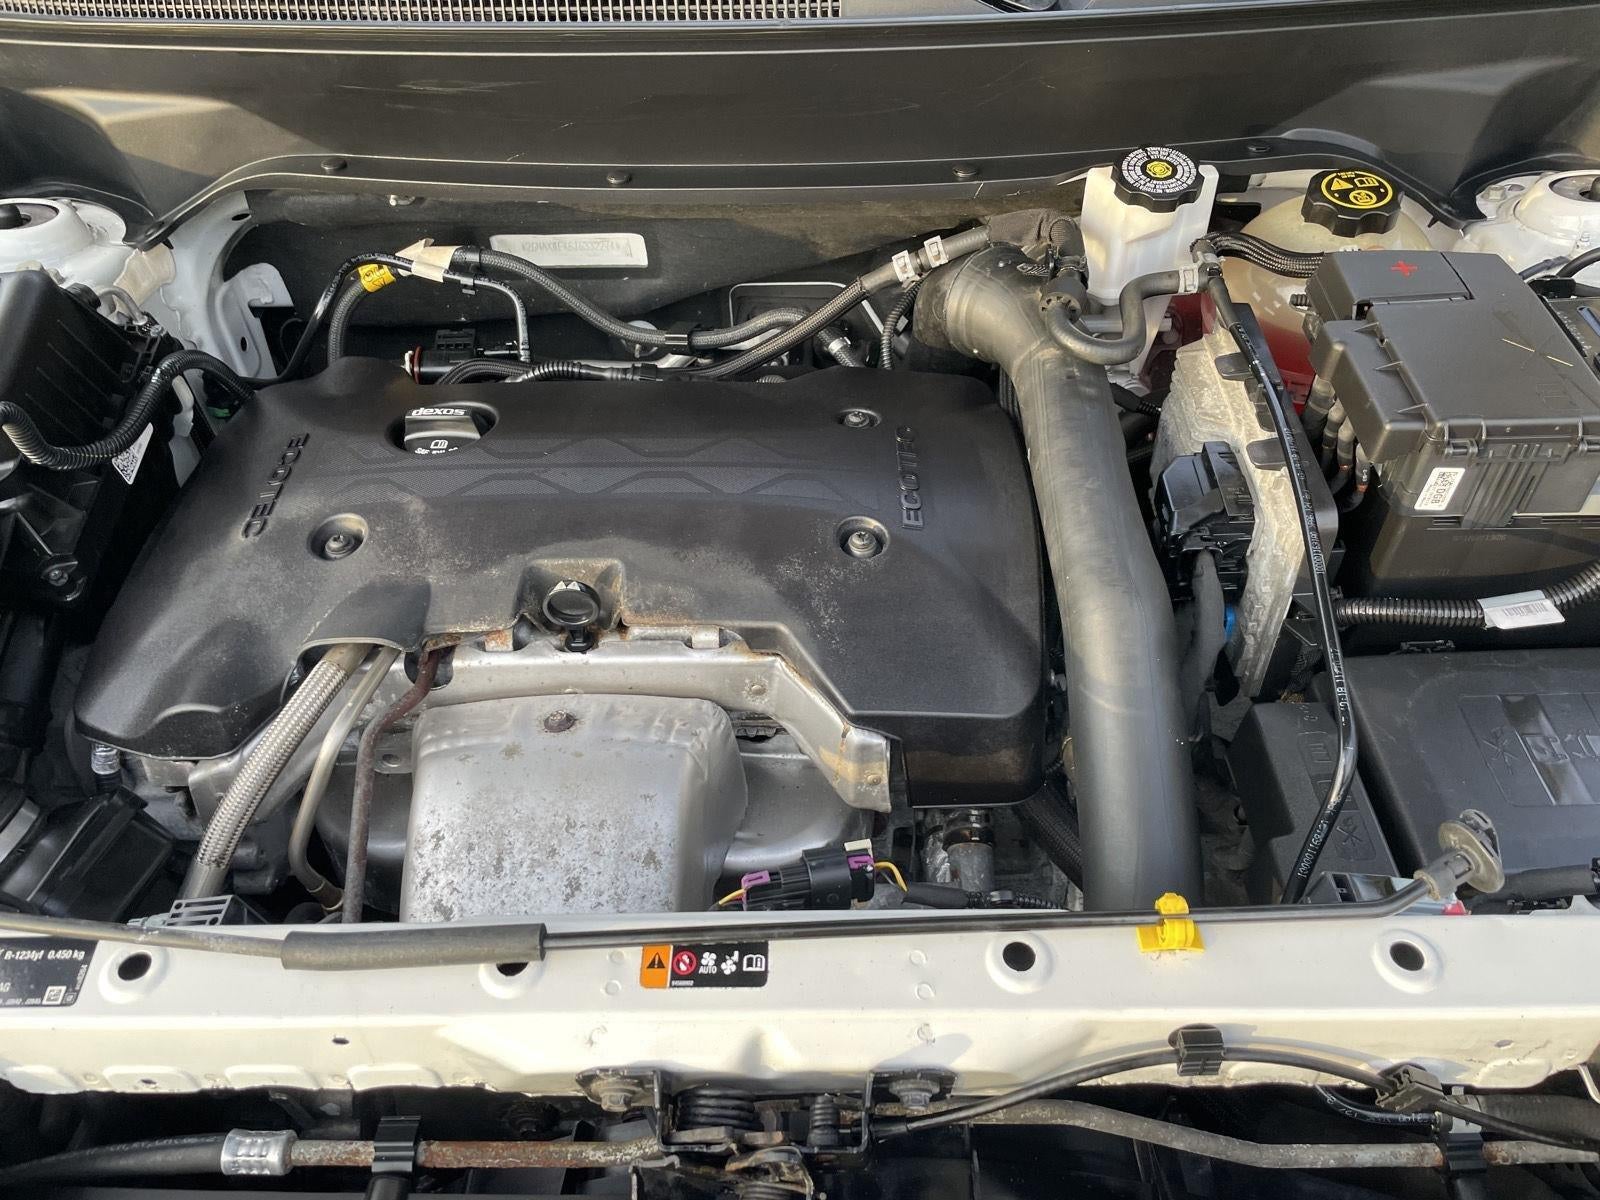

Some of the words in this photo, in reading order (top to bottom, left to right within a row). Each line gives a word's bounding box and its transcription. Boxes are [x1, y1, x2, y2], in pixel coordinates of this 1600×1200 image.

[411, 407, 467, 416] dexos
[4, 949, 44, 961] R-1234yf
[47, 949, 73, 960] 0.450
[73, 949, 86, 961] kg
[698, 965, 718, 974] AUTO
